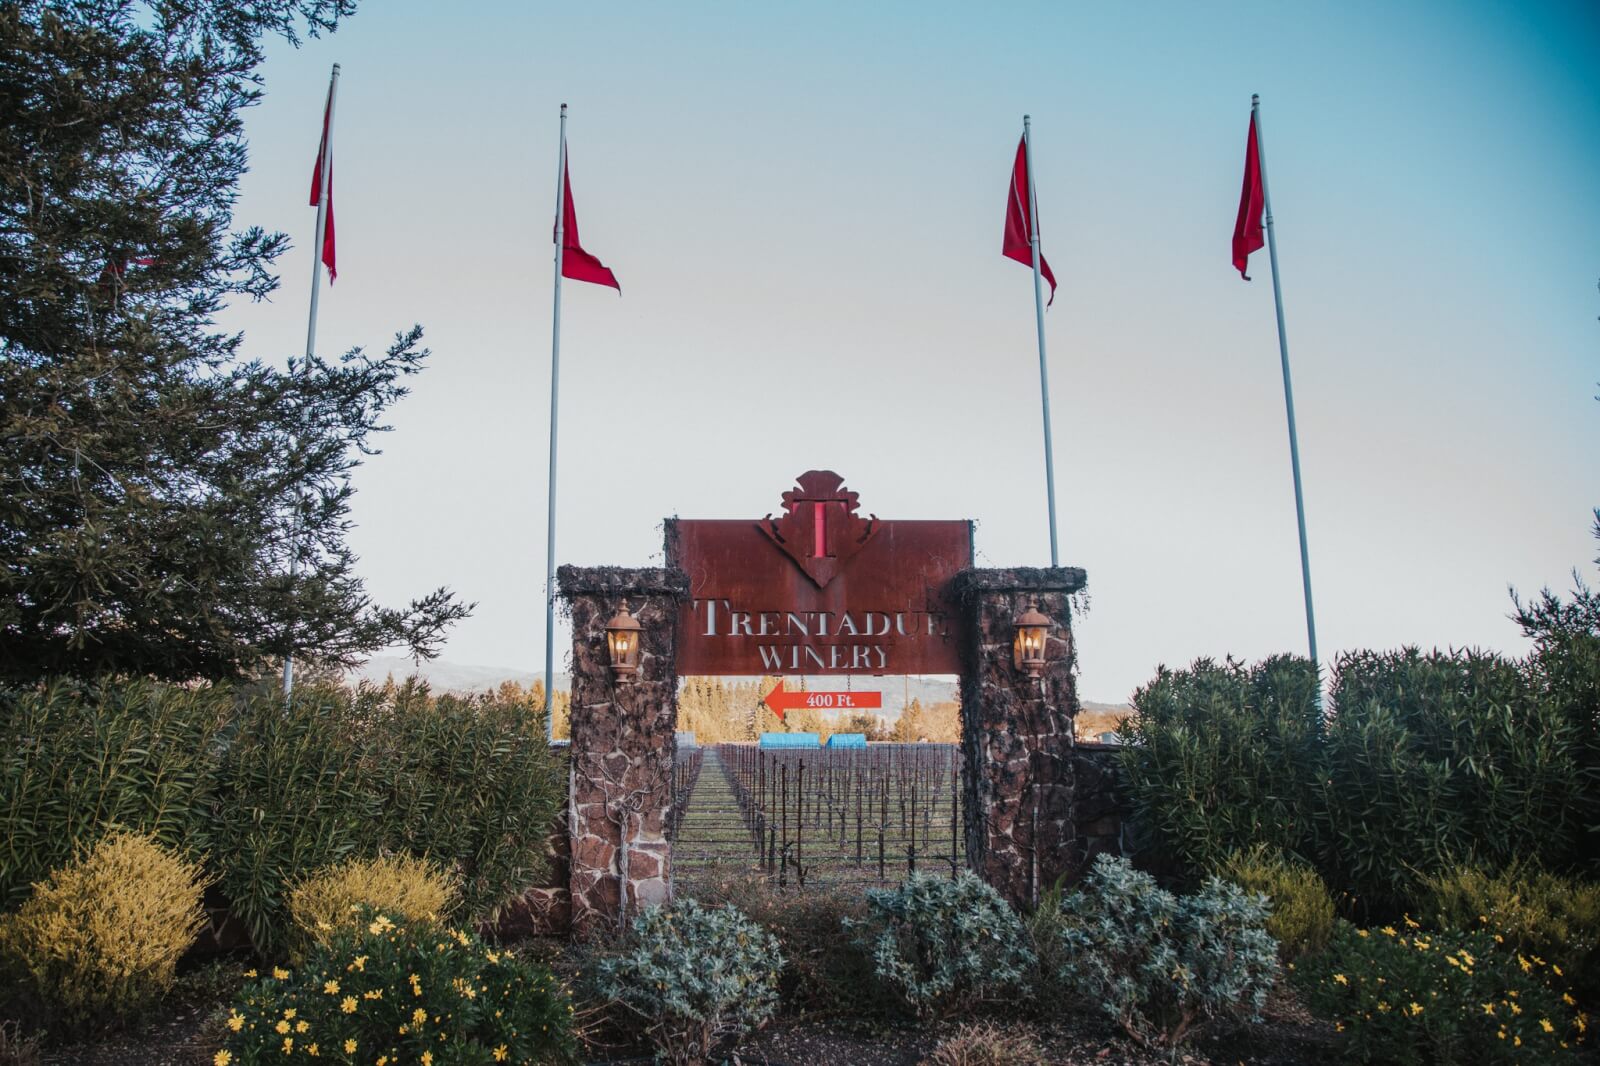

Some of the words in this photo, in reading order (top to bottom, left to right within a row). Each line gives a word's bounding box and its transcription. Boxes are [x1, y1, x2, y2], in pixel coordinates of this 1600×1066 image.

[758, 643, 893, 670] WINERY
[806, 692, 833, 707] 400
[836, 694, 855, 707] Ft.
